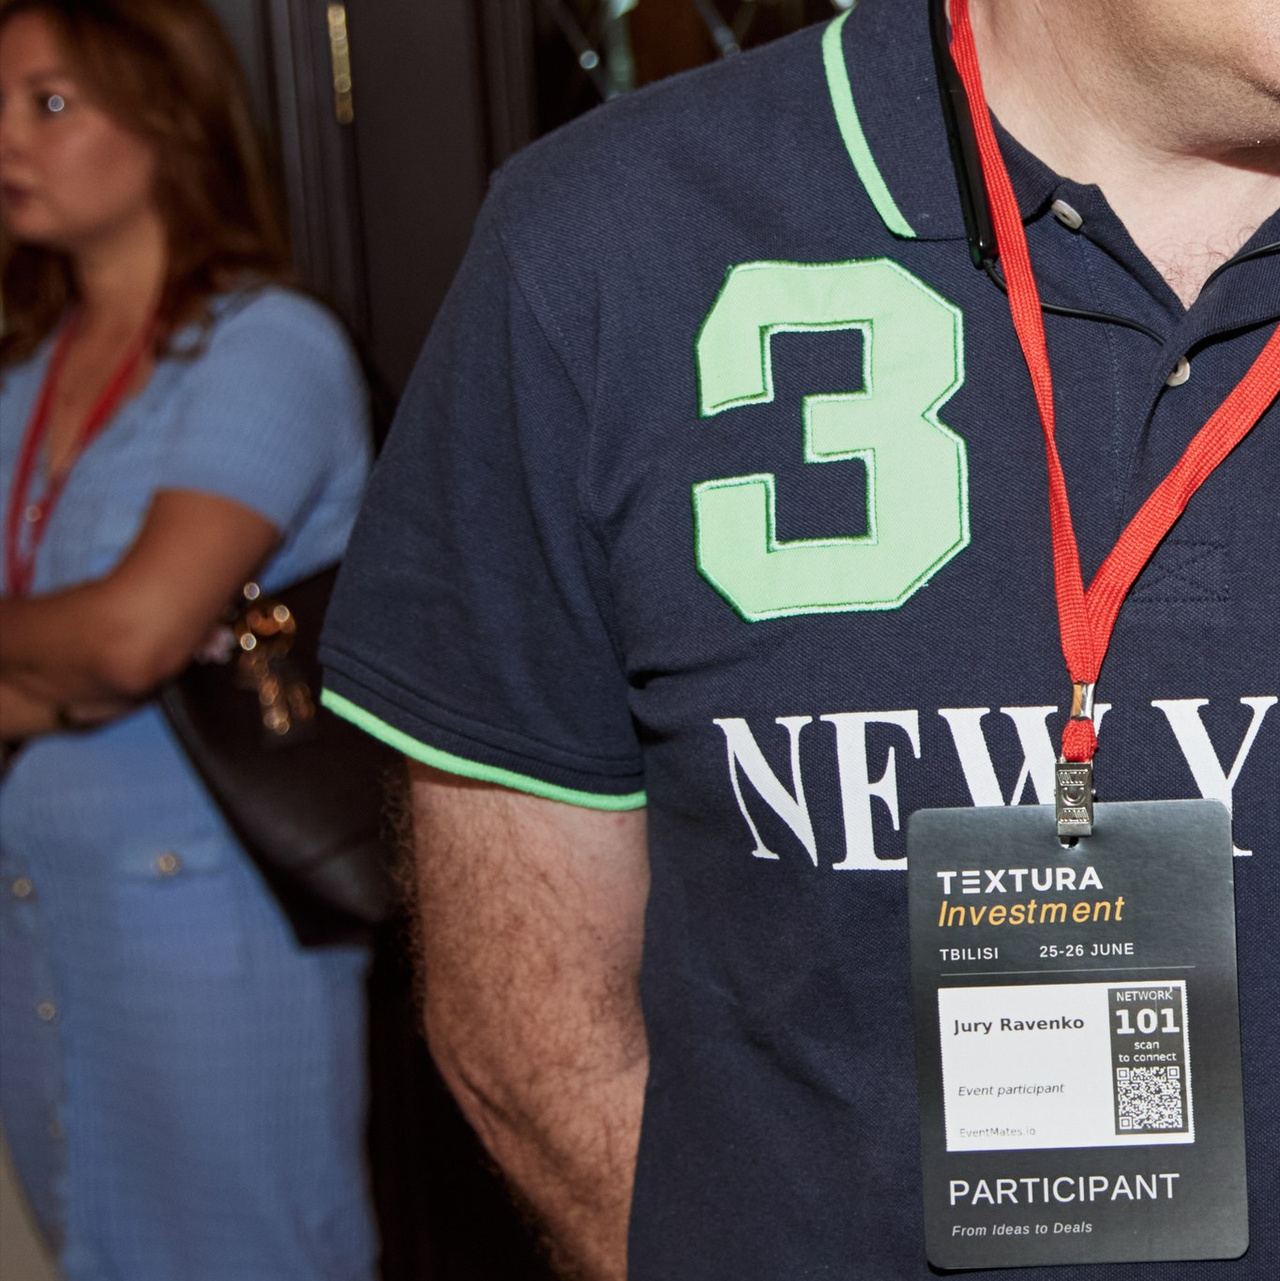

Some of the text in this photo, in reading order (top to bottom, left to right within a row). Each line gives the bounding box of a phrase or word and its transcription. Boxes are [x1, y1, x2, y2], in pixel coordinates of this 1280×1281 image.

[693, 257, 969, 621] 3
[937, 866, 1104, 895] TEXTURA
[938, 896, 1125, 927] Investment
[939, 942, 1135, 961] TBILISI 25-26 JUNE
[1116, 990, 1173, 1002] NETWORK
[954, 1016, 1085, 1036] Jury Ravenko
[1115, 1008, 1181, 1035] 101
[1134, 1041, 1160, 1050] scan
[1118, 1053, 1177, 1062] to connect
[958, 1083, 1065, 1098] Event participant
[959, 1126, 1036, 1138] EventMates.io
[949, 1173, 1180, 1206] PARTICIPANT
[952, 1221, 1093, 1237] From Ideas to Deals
